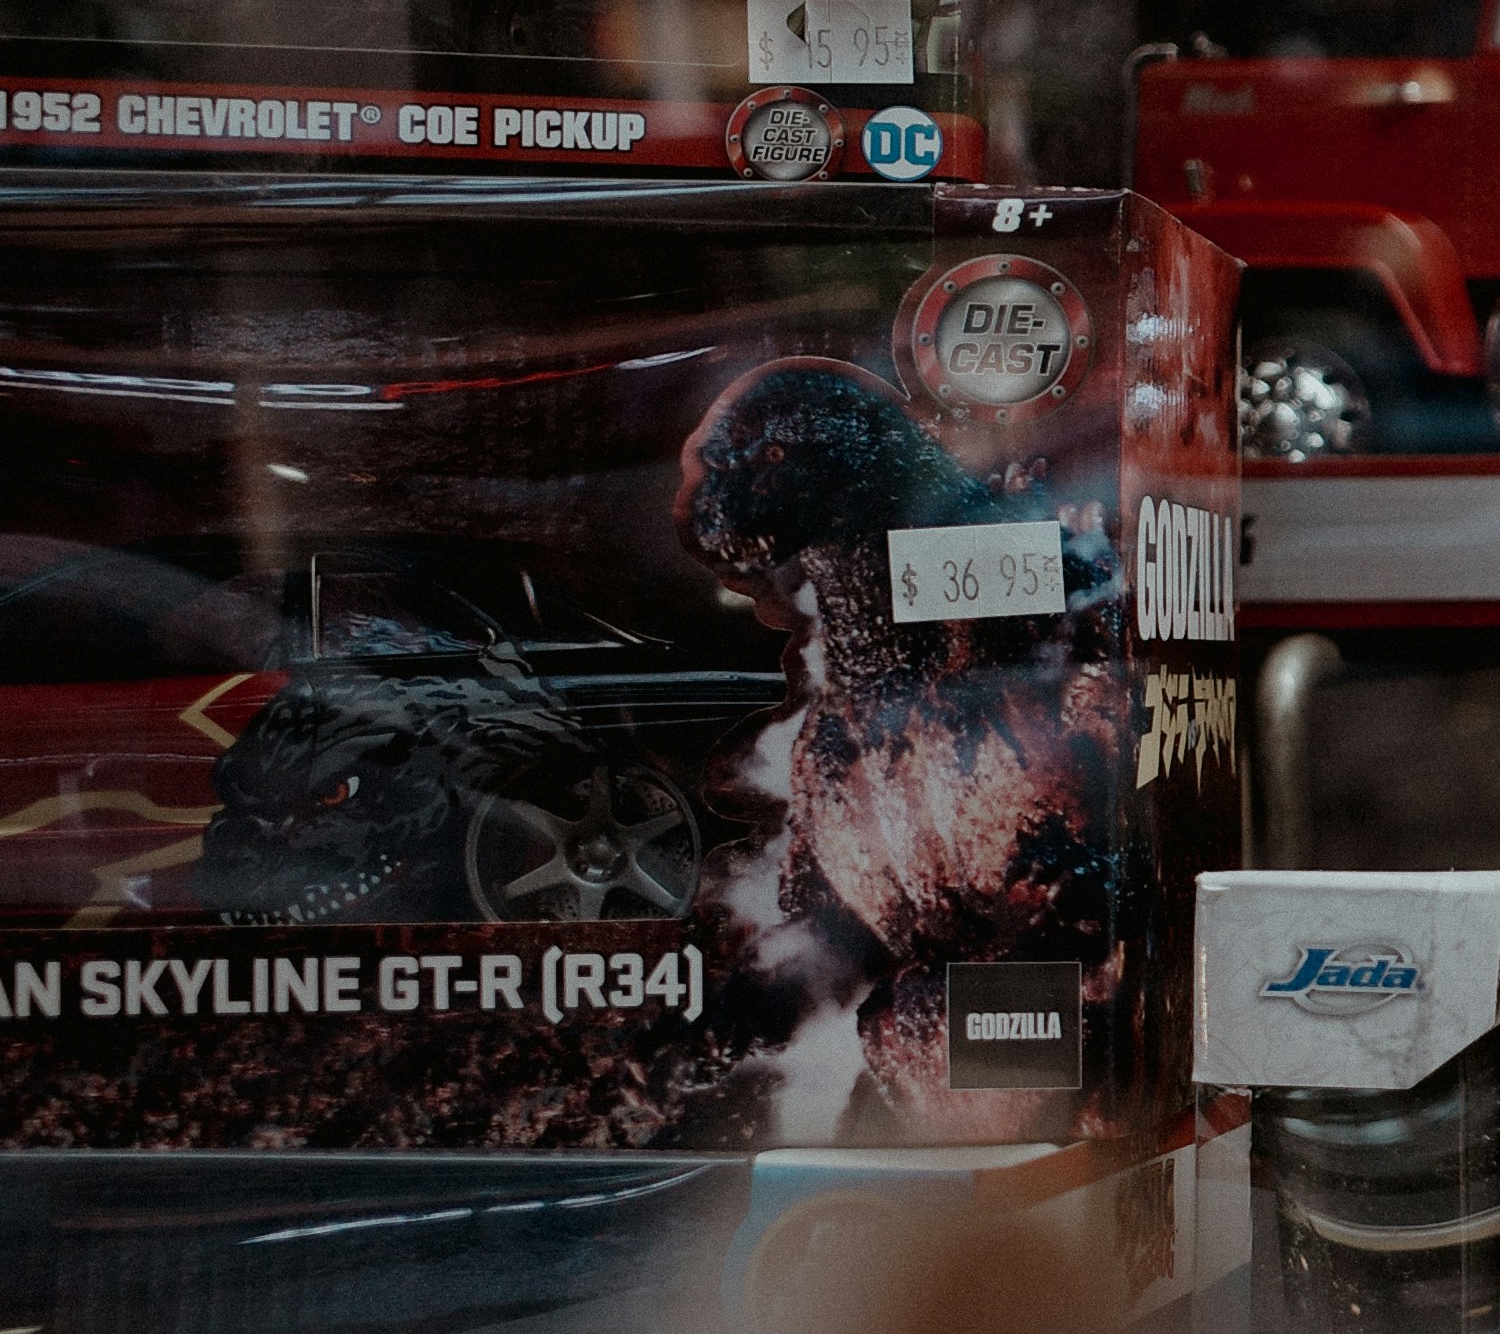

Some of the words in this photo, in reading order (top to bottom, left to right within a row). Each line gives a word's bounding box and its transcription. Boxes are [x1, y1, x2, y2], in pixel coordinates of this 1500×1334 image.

[854, 25, 889, 67] 95
[0, 90, 101, 133] 1952
[399, 103, 479, 146] COE
[494, 105, 646, 152] PICKUP
[762, 127, 816, 145] CAST
[768, 109, 811, 126] DIE-
[752, 145, 827, 164] FIGURE
[867, 122, 937, 167] DC
[991, 197, 1053, 234] 8+
[961, 302, 1047, 336] DIE-
[948, 343, 1061, 376] CAST
[902, 563, 918, 606] $
[943, 558, 980, 603] 36
[1000, 553, 1039, 597] 95
[1136, 494, 1236, 642] GODZILLA
[80, 955, 362, 1016] SKYLINE
[378, 952, 525, 1011] GT-R
[541, 942, 704, 1024] (R34)
[1266, 946, 1418, 997] Jada
[965, 1012, 1062, 1041] GODZILLA
